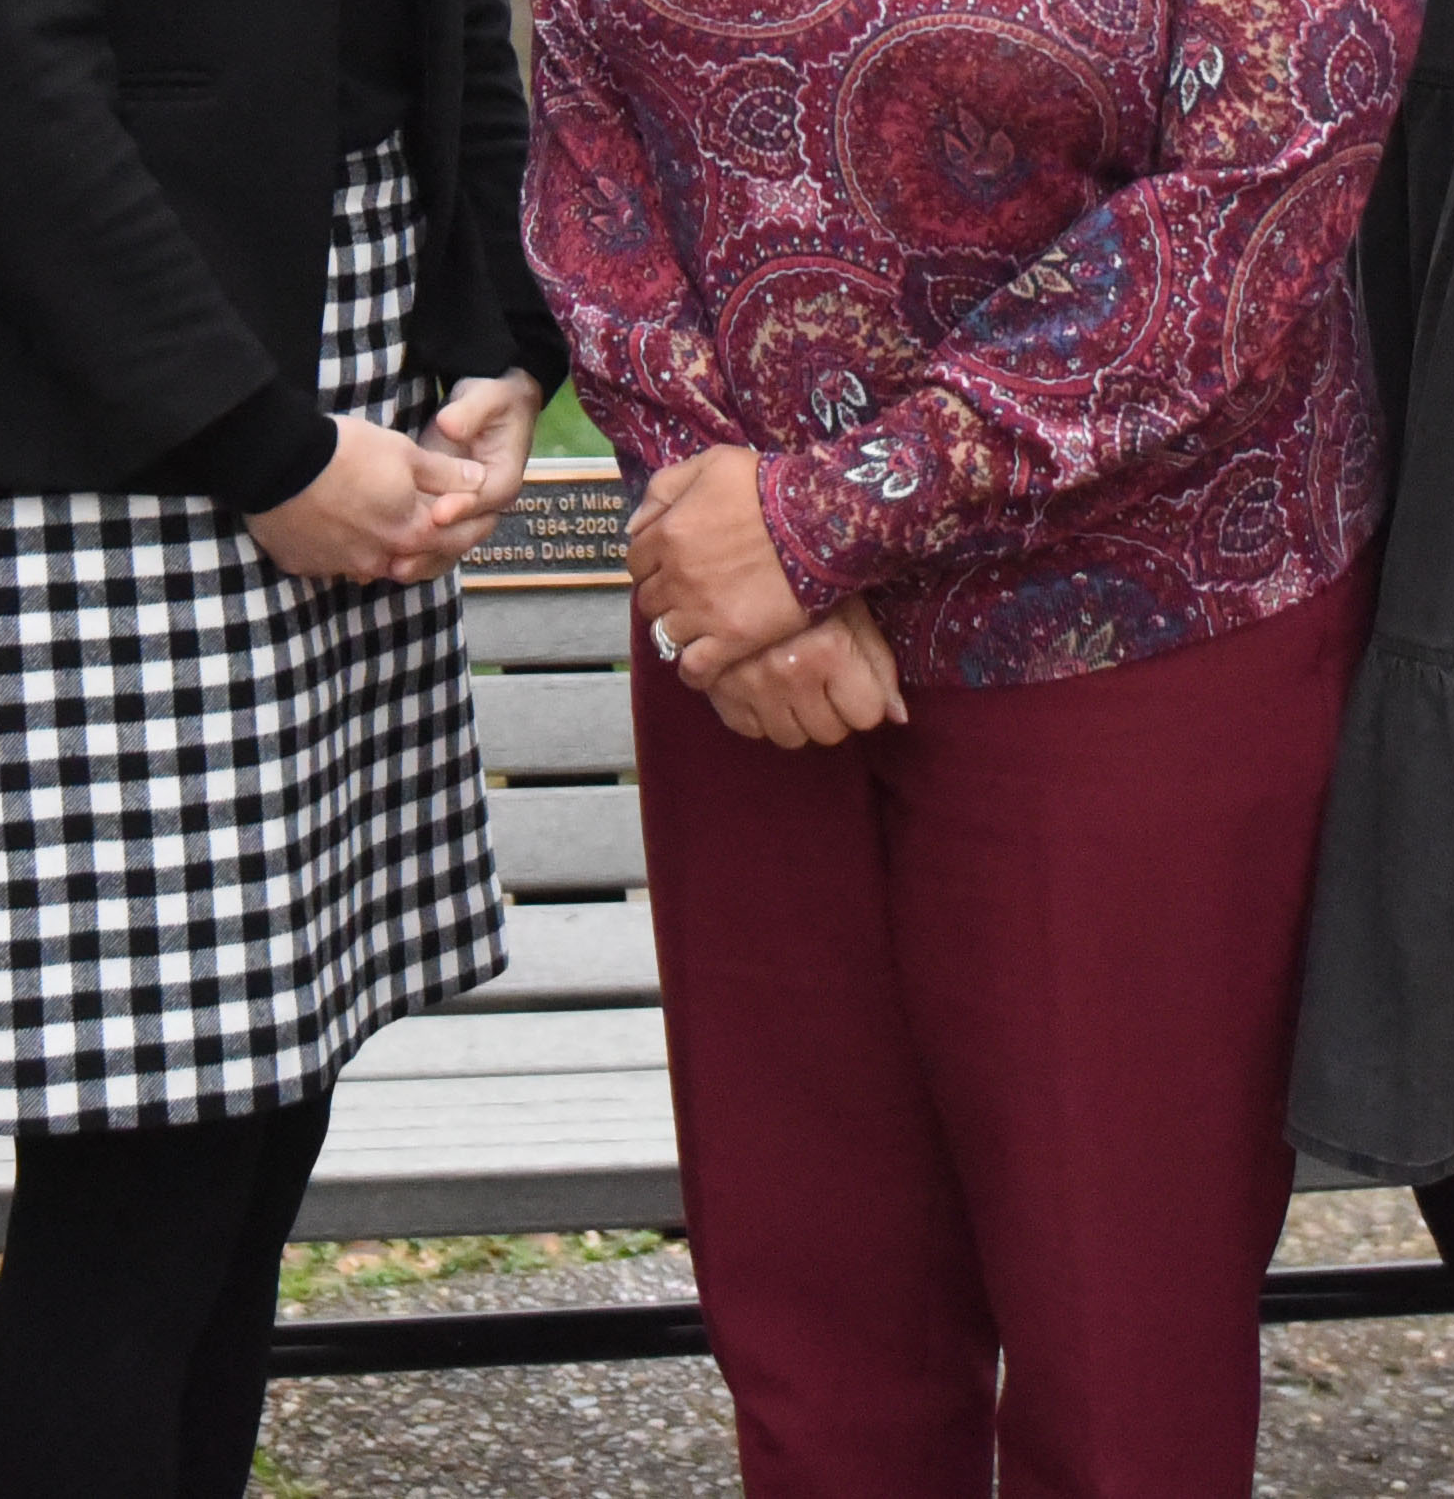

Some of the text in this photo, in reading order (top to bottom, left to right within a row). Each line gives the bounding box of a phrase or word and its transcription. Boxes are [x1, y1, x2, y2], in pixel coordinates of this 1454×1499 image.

[559, 494, 576, 511] of
[582, 493, 623, 511] Mike
[527, 517, 618, 536] 1984-2020
[541, 541, 595, 560] Dukes
[602, 541, 628, 558] Ice
